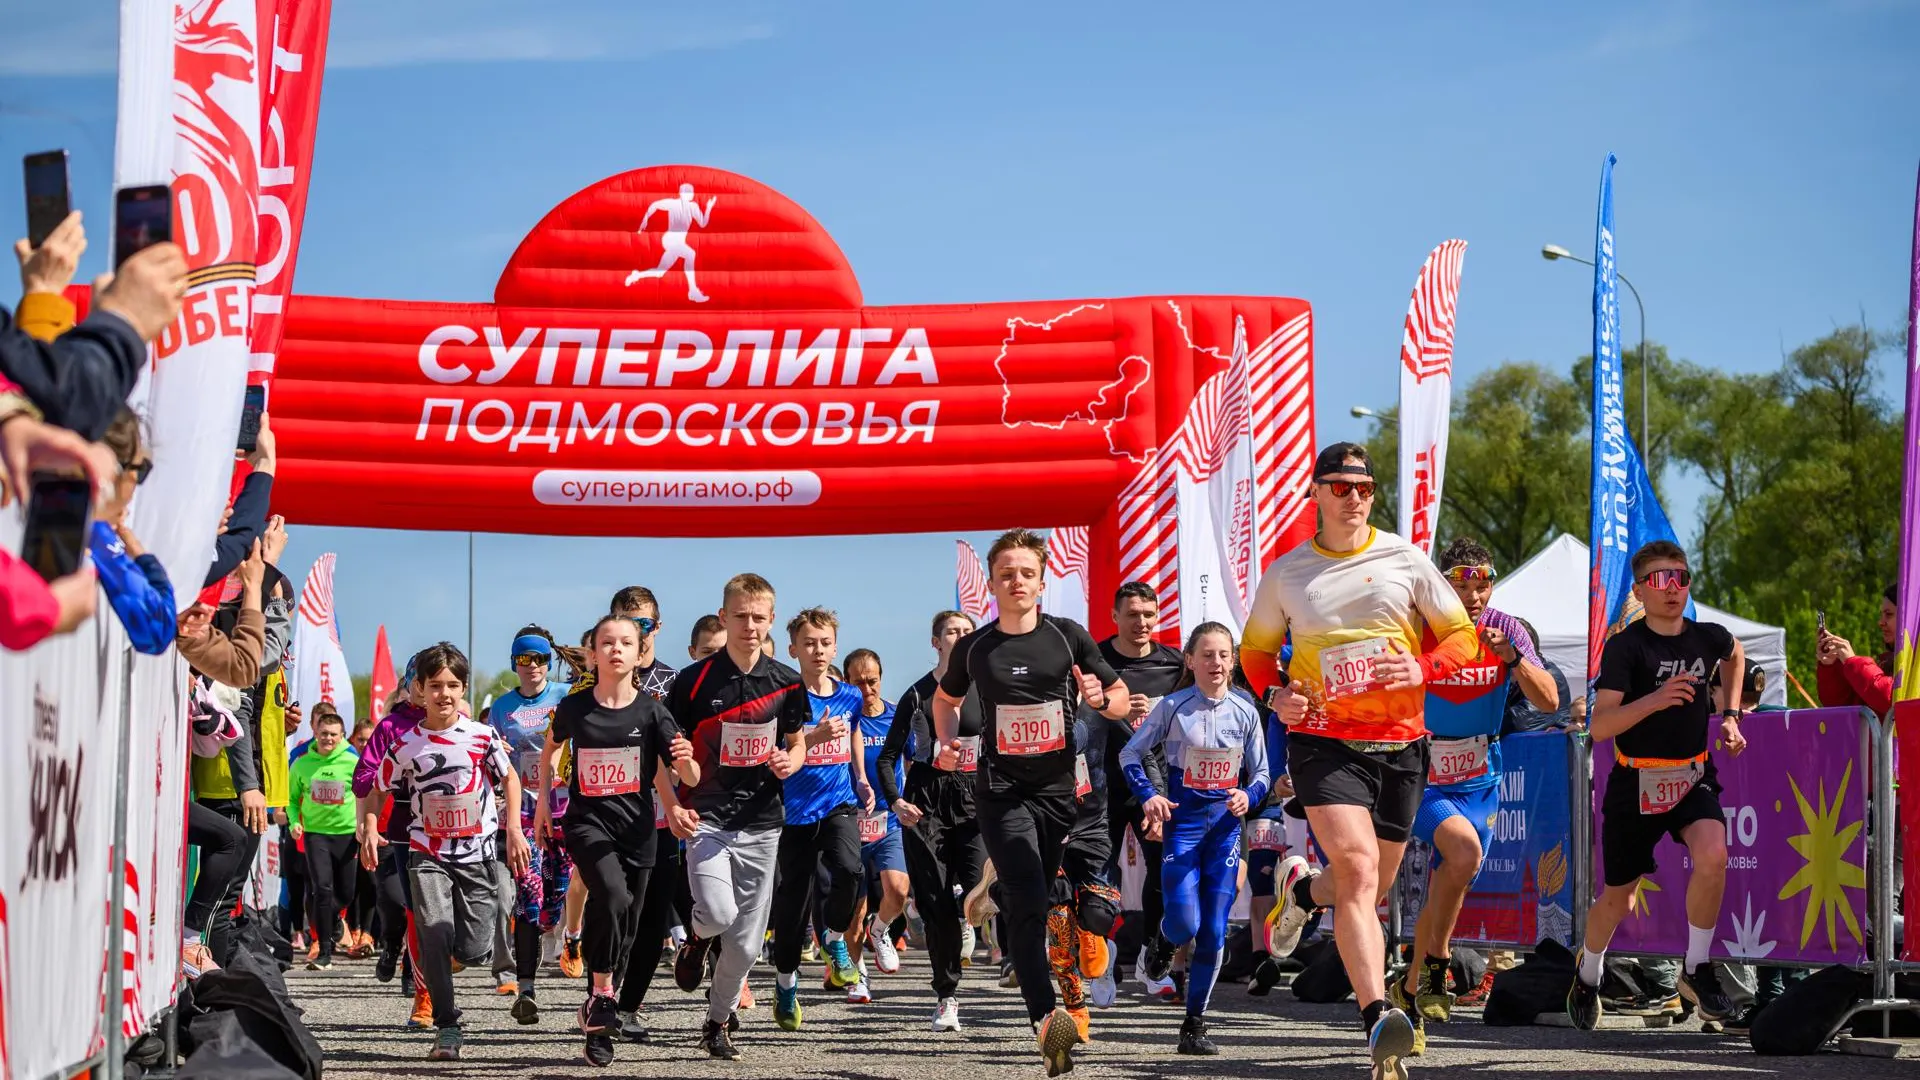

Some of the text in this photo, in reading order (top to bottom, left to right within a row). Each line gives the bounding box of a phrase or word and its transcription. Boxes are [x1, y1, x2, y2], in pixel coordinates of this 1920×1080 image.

[250, 14, 303, 390] ПОРТ
[152, 285, 252, 366] ОБЕ
[417, 324, 940, 389] СУПЕРЛИГА
[415, 397, 941, 454] ПОДМОСКОВЬЯ
[560, 476, 794, 503] суперлигамо.рф
[1427, 665, 1499, 686] SSIA
[1656, 657, 1706, 678] FILA
[523, 717, 545, 728] RUN
[1011, 719, 1050, 742] 3190
[734, 736, 768, 756] 3189
[863, 735, 887, 747] ЗАБЕ
[958, 748, 974, 763] 05
[1441, 751, 1475, 774] 3129
[589, 763, 626, 785] 3126
[1197, 761, 1231, 780] 3139
[317, 788, 338, 799] 3109
[435, 808, 468, 828] 3011
[857, 820, 879, 834] 050
[1722, 805, 1758, 847] ТО
[1254, 829, 1279, 843] 3106
